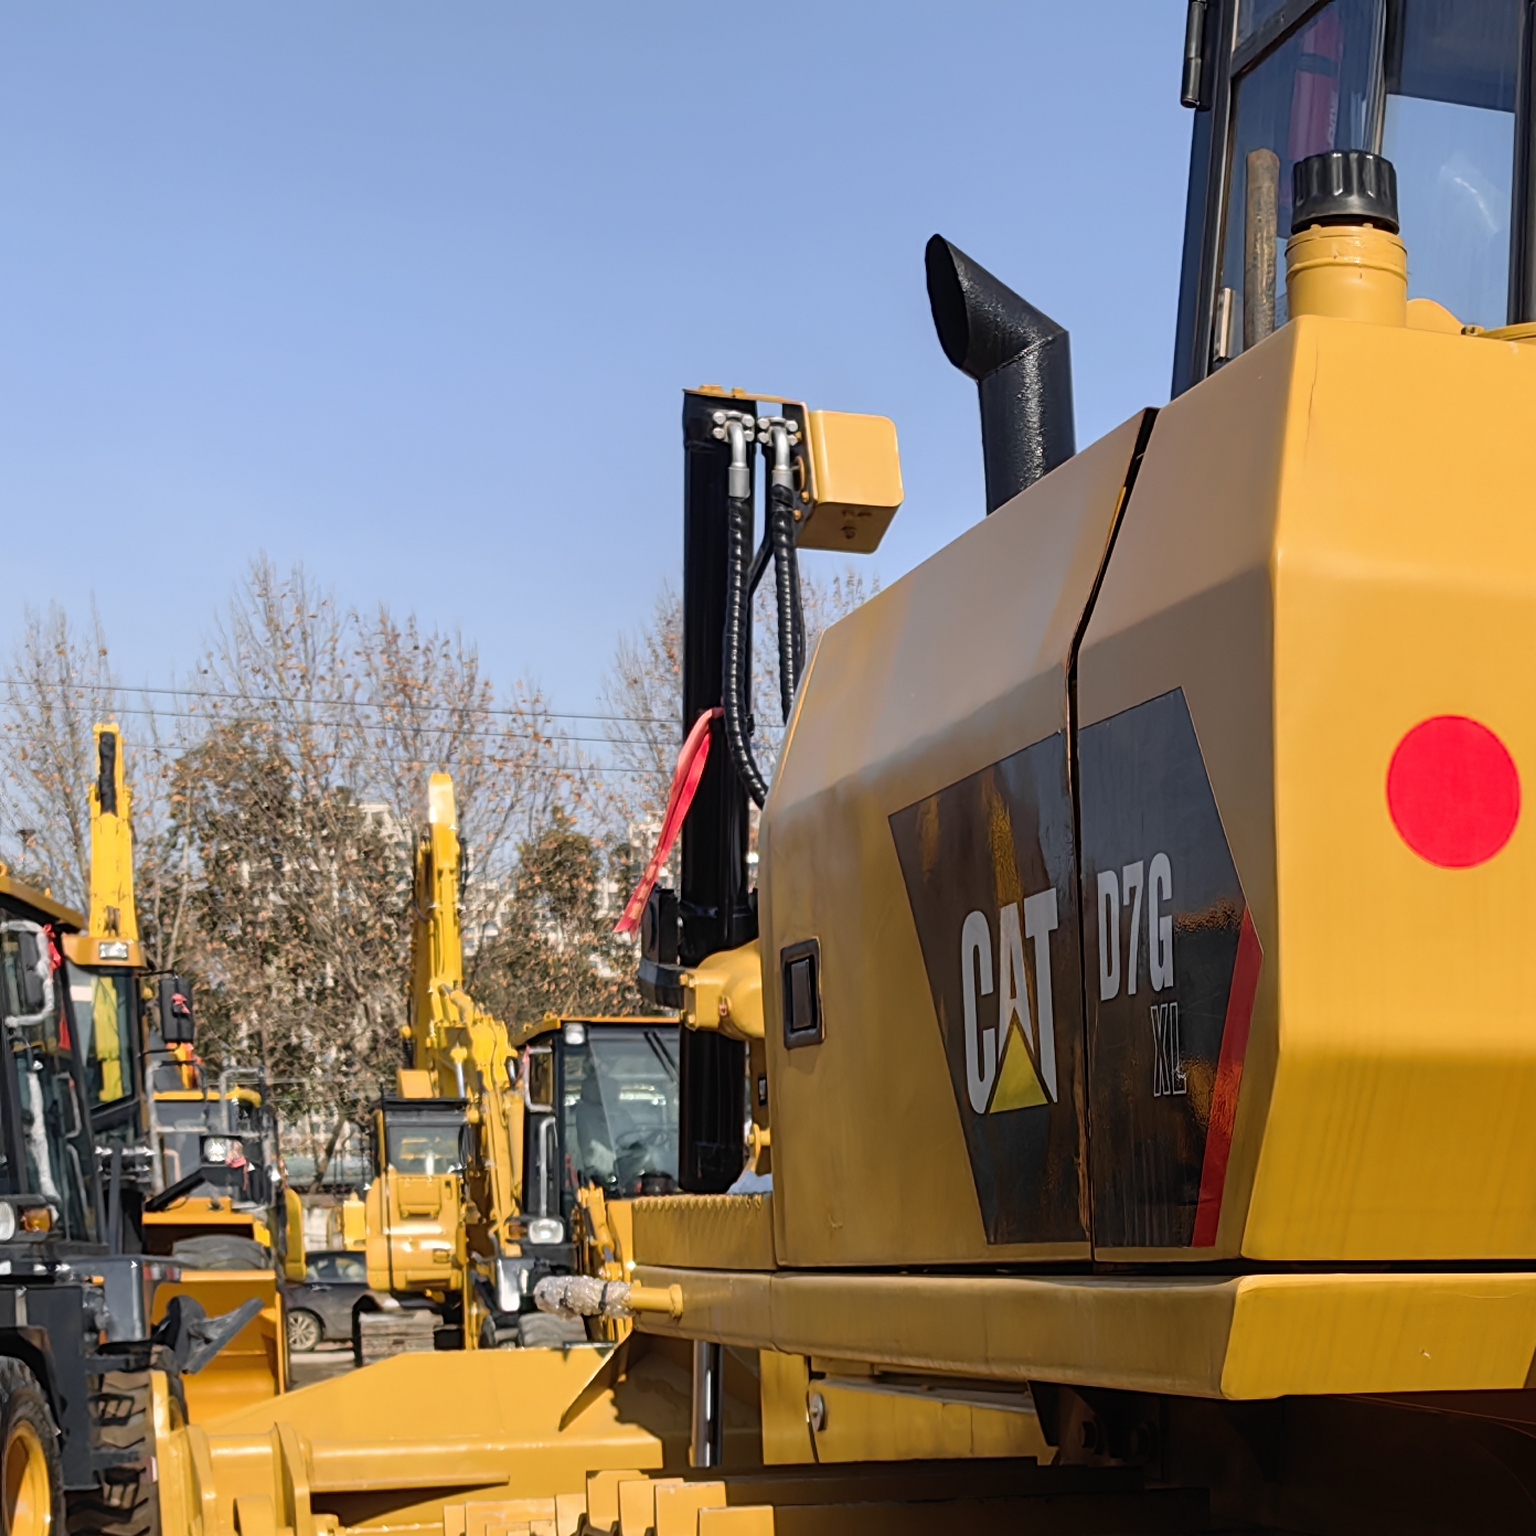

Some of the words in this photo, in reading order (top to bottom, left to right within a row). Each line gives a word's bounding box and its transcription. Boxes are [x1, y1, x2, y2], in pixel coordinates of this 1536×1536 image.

[961, 887, 1059, 1115] CAT
[1098, 852, 1174, 1001] D7G
[1150, 1001, 1187, 1097] XL
